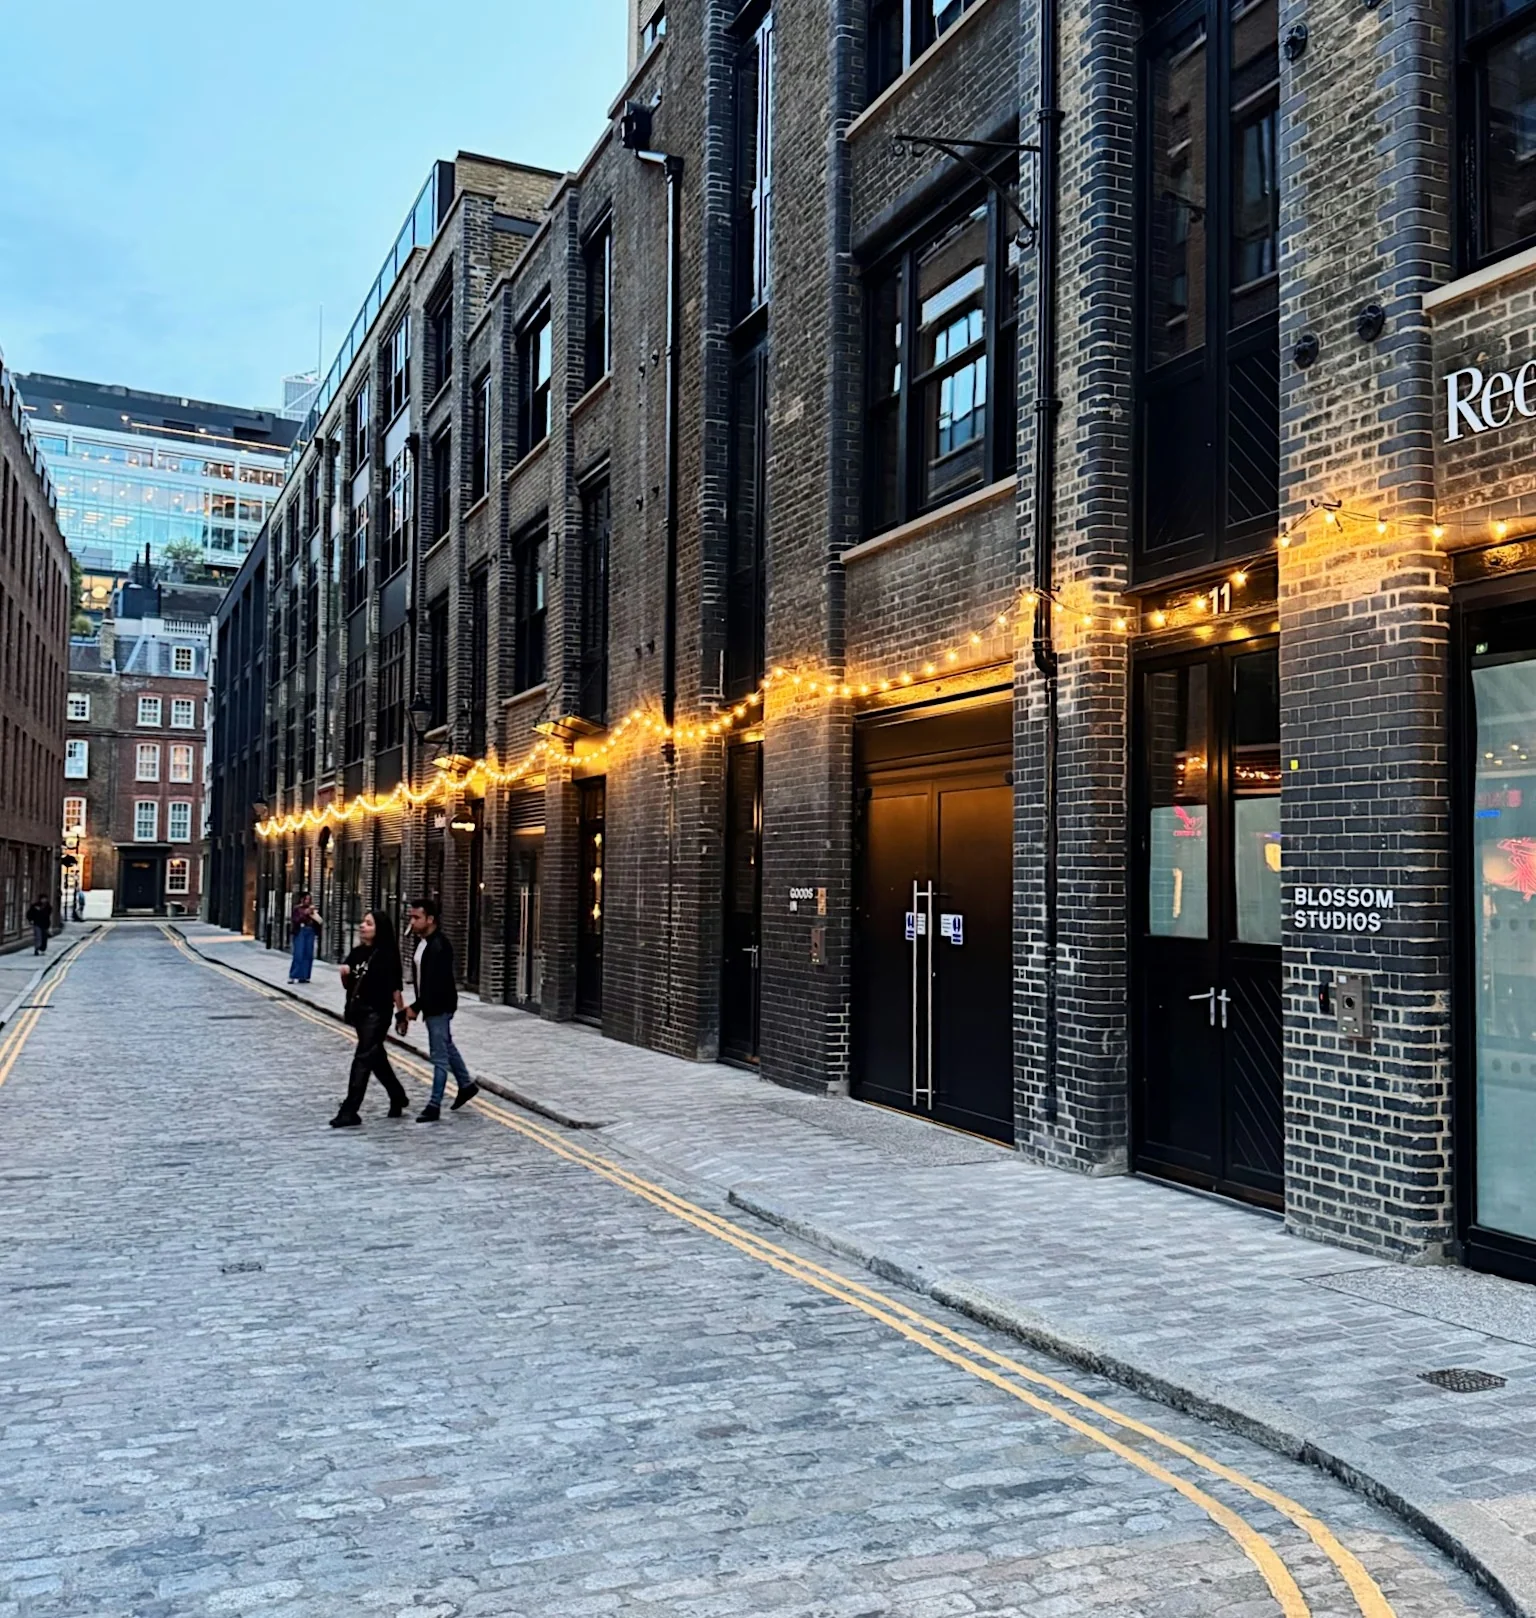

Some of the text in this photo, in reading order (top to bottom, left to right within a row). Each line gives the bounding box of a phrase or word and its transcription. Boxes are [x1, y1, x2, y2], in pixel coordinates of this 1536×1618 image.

[1209, 582, 1231, 615] 11
[790, 887, 814, 899] GOODS
[1294, 887, 1395, 909] BLOSSOM
[1294, 911, 1382, 932] STUDIOS
